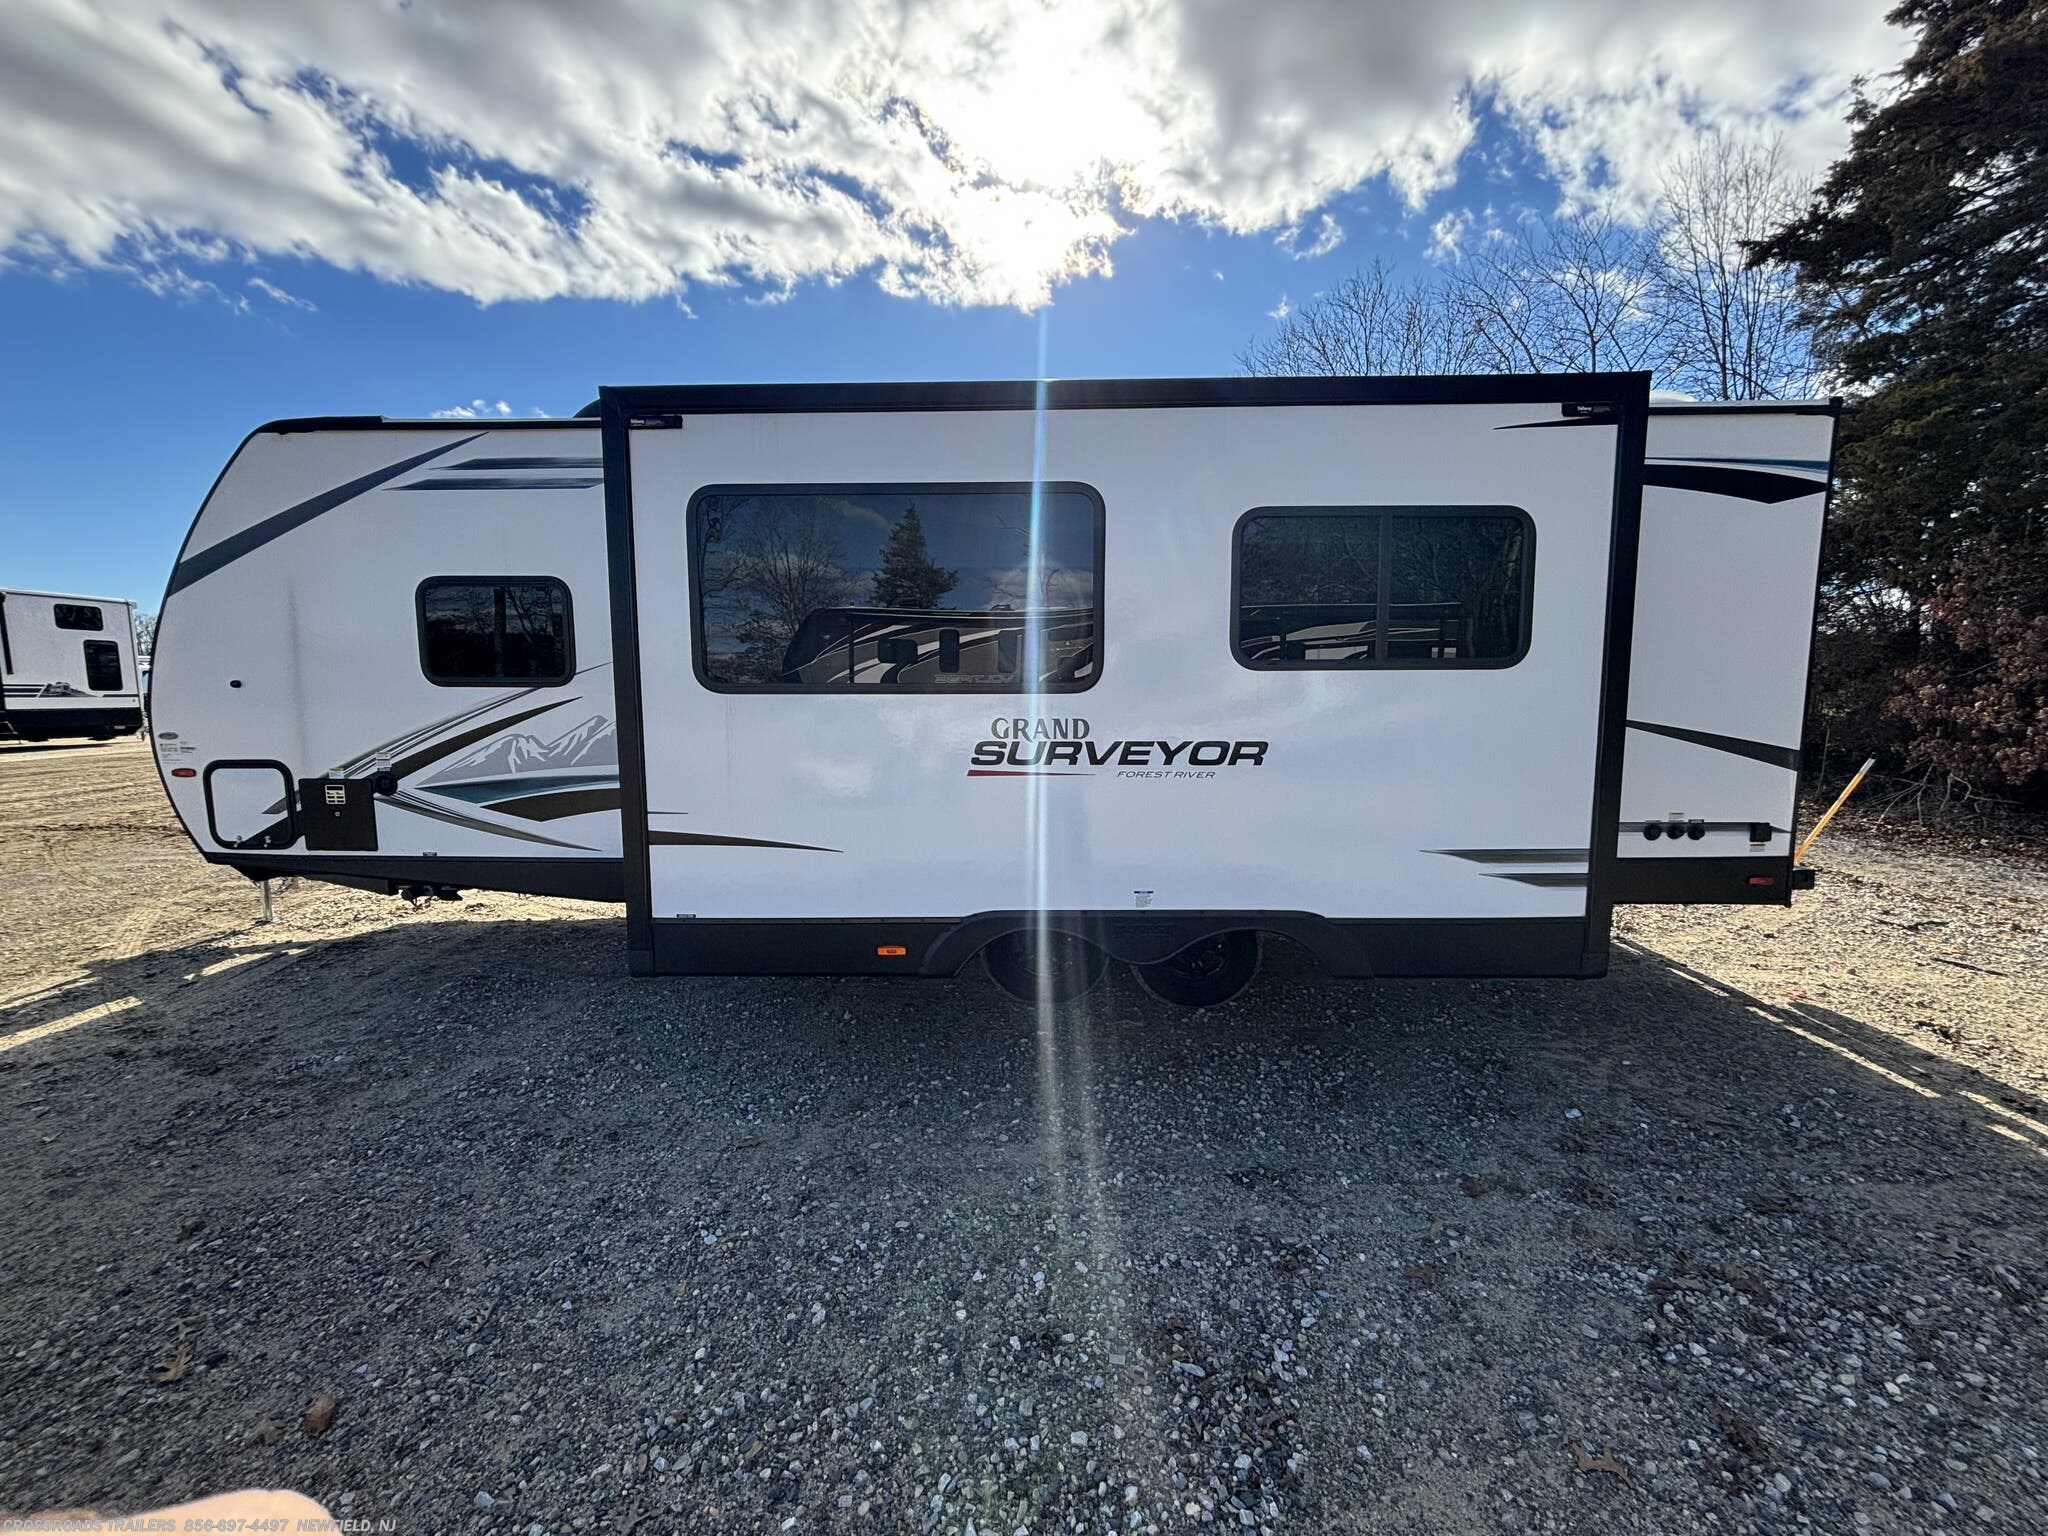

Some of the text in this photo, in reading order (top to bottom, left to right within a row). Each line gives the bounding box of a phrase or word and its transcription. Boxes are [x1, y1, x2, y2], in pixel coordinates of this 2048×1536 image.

[991, 717, 1090, 742] GRAND
[970, 740, 1269, 766] SURVEYOR
[1117, 770, 1216, 779] FOREST RIVER
